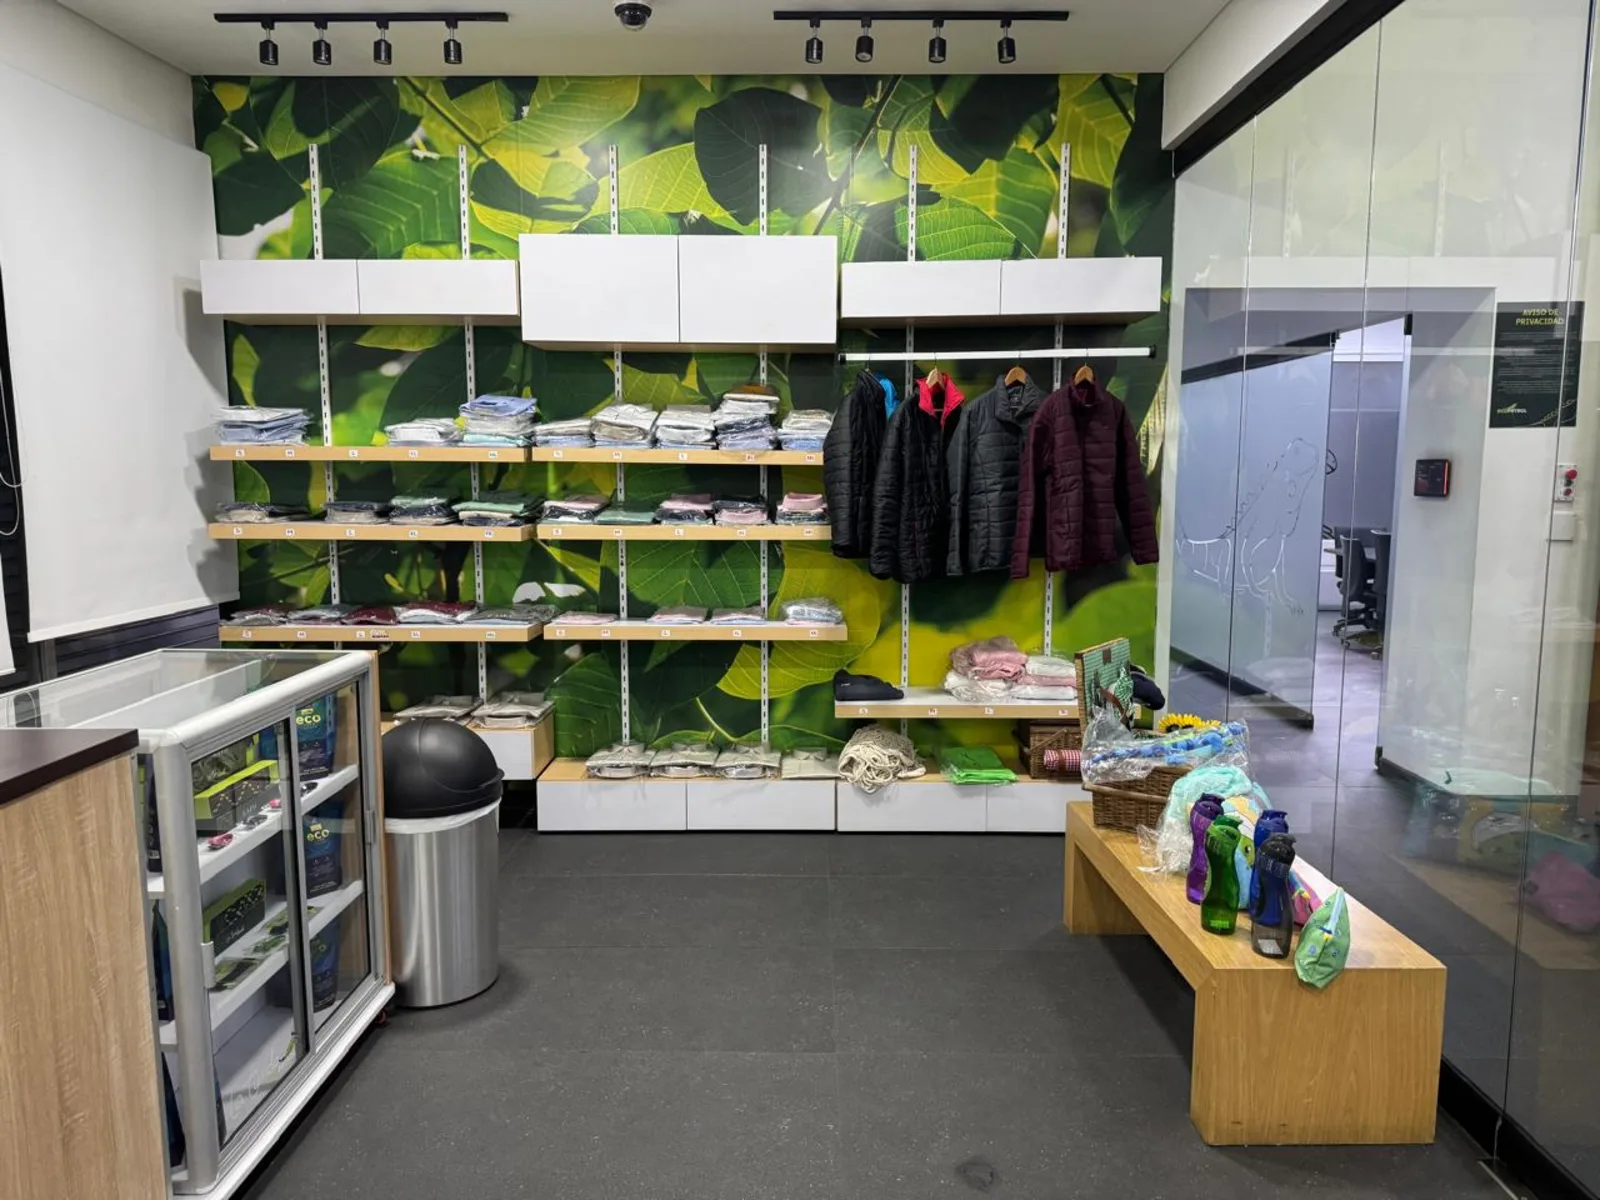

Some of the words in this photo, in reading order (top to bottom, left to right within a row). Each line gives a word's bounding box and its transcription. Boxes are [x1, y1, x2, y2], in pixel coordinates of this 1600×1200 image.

[1522, 308, 1547, 316] AVISO
[1549, 308, 1560, 316] DE
[1515, 318, 1564, 326] PRIVACIDAD
[296, 714, 321, 725] eco
[307, 829, 330, 841] eco
